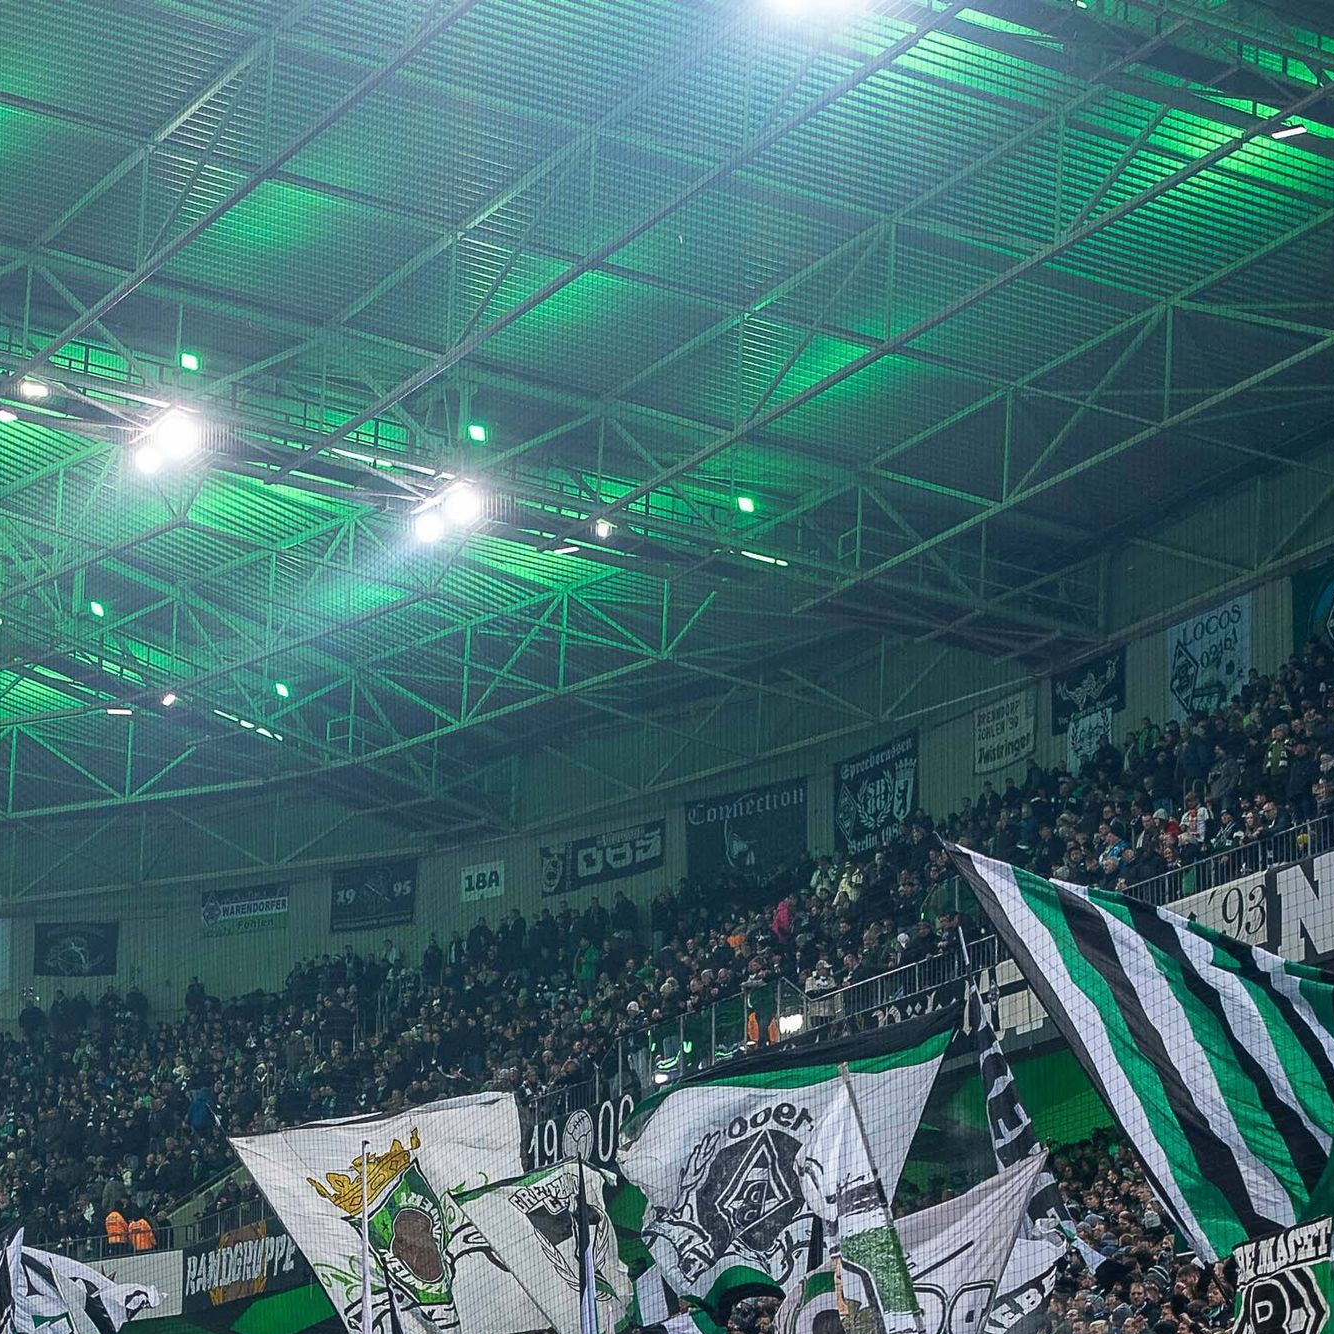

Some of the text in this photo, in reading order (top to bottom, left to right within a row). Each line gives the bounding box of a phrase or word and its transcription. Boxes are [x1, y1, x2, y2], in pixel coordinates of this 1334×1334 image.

[1181, 604, 1242, 646] LOCOS
[688, 788, 804, 826] Connection
[464, 870, 501, 892] 18A
[222, 899, 288, 917] WARENDORFER
[185, 1233, 296, 1297] RANDGRUPPE
[1257, 1217, 1332, 1275] MACHT
